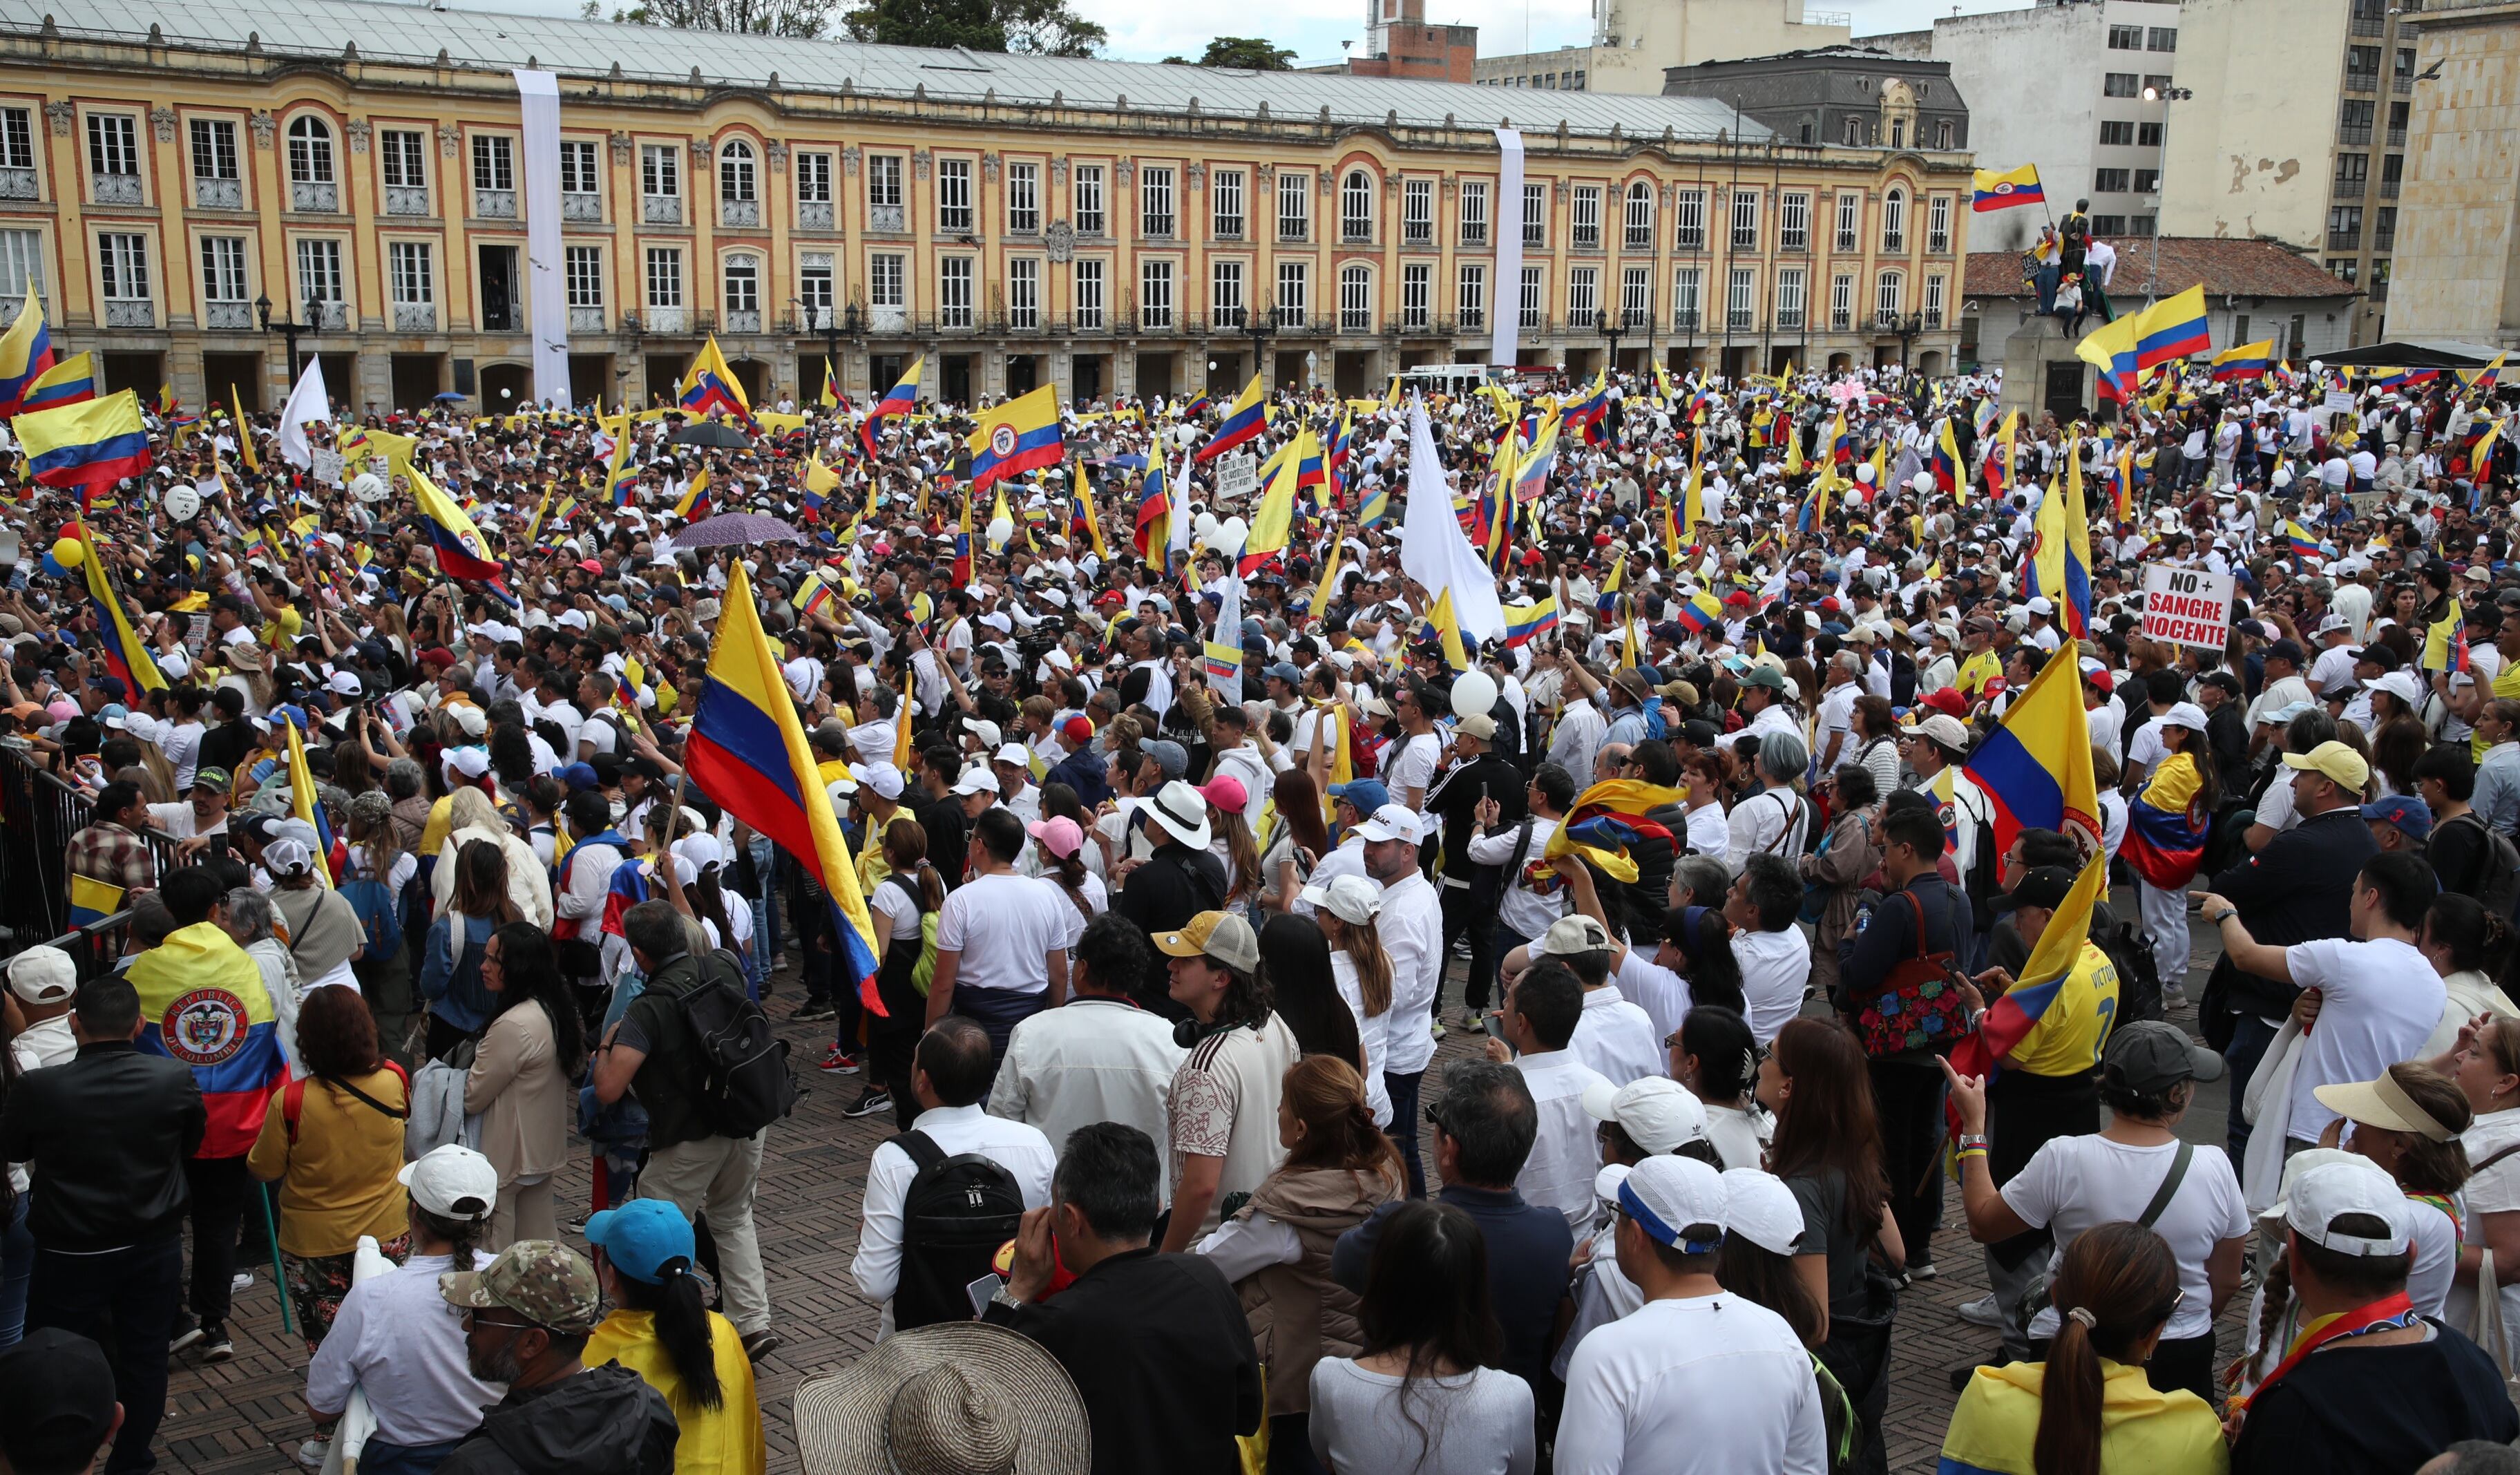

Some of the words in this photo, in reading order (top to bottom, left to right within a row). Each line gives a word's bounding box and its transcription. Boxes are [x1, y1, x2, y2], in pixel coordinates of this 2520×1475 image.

[2168, 572, 2197, 593] NO
[2202, 580, 2213, 592] +
[2148, 592, 2222, 621] SANGRE
[2143, 614, 2226, 646] INOCENTE
[1206, 658, 1233, 669] COLOMBIA
[2090, 964, 2116, 989] VICTOR
[170, 990, 245, 1017] REPUBLICA
[166, 1036, 180, 1053] DE
[178, 1036, 244, 1064] COLOMBIA
